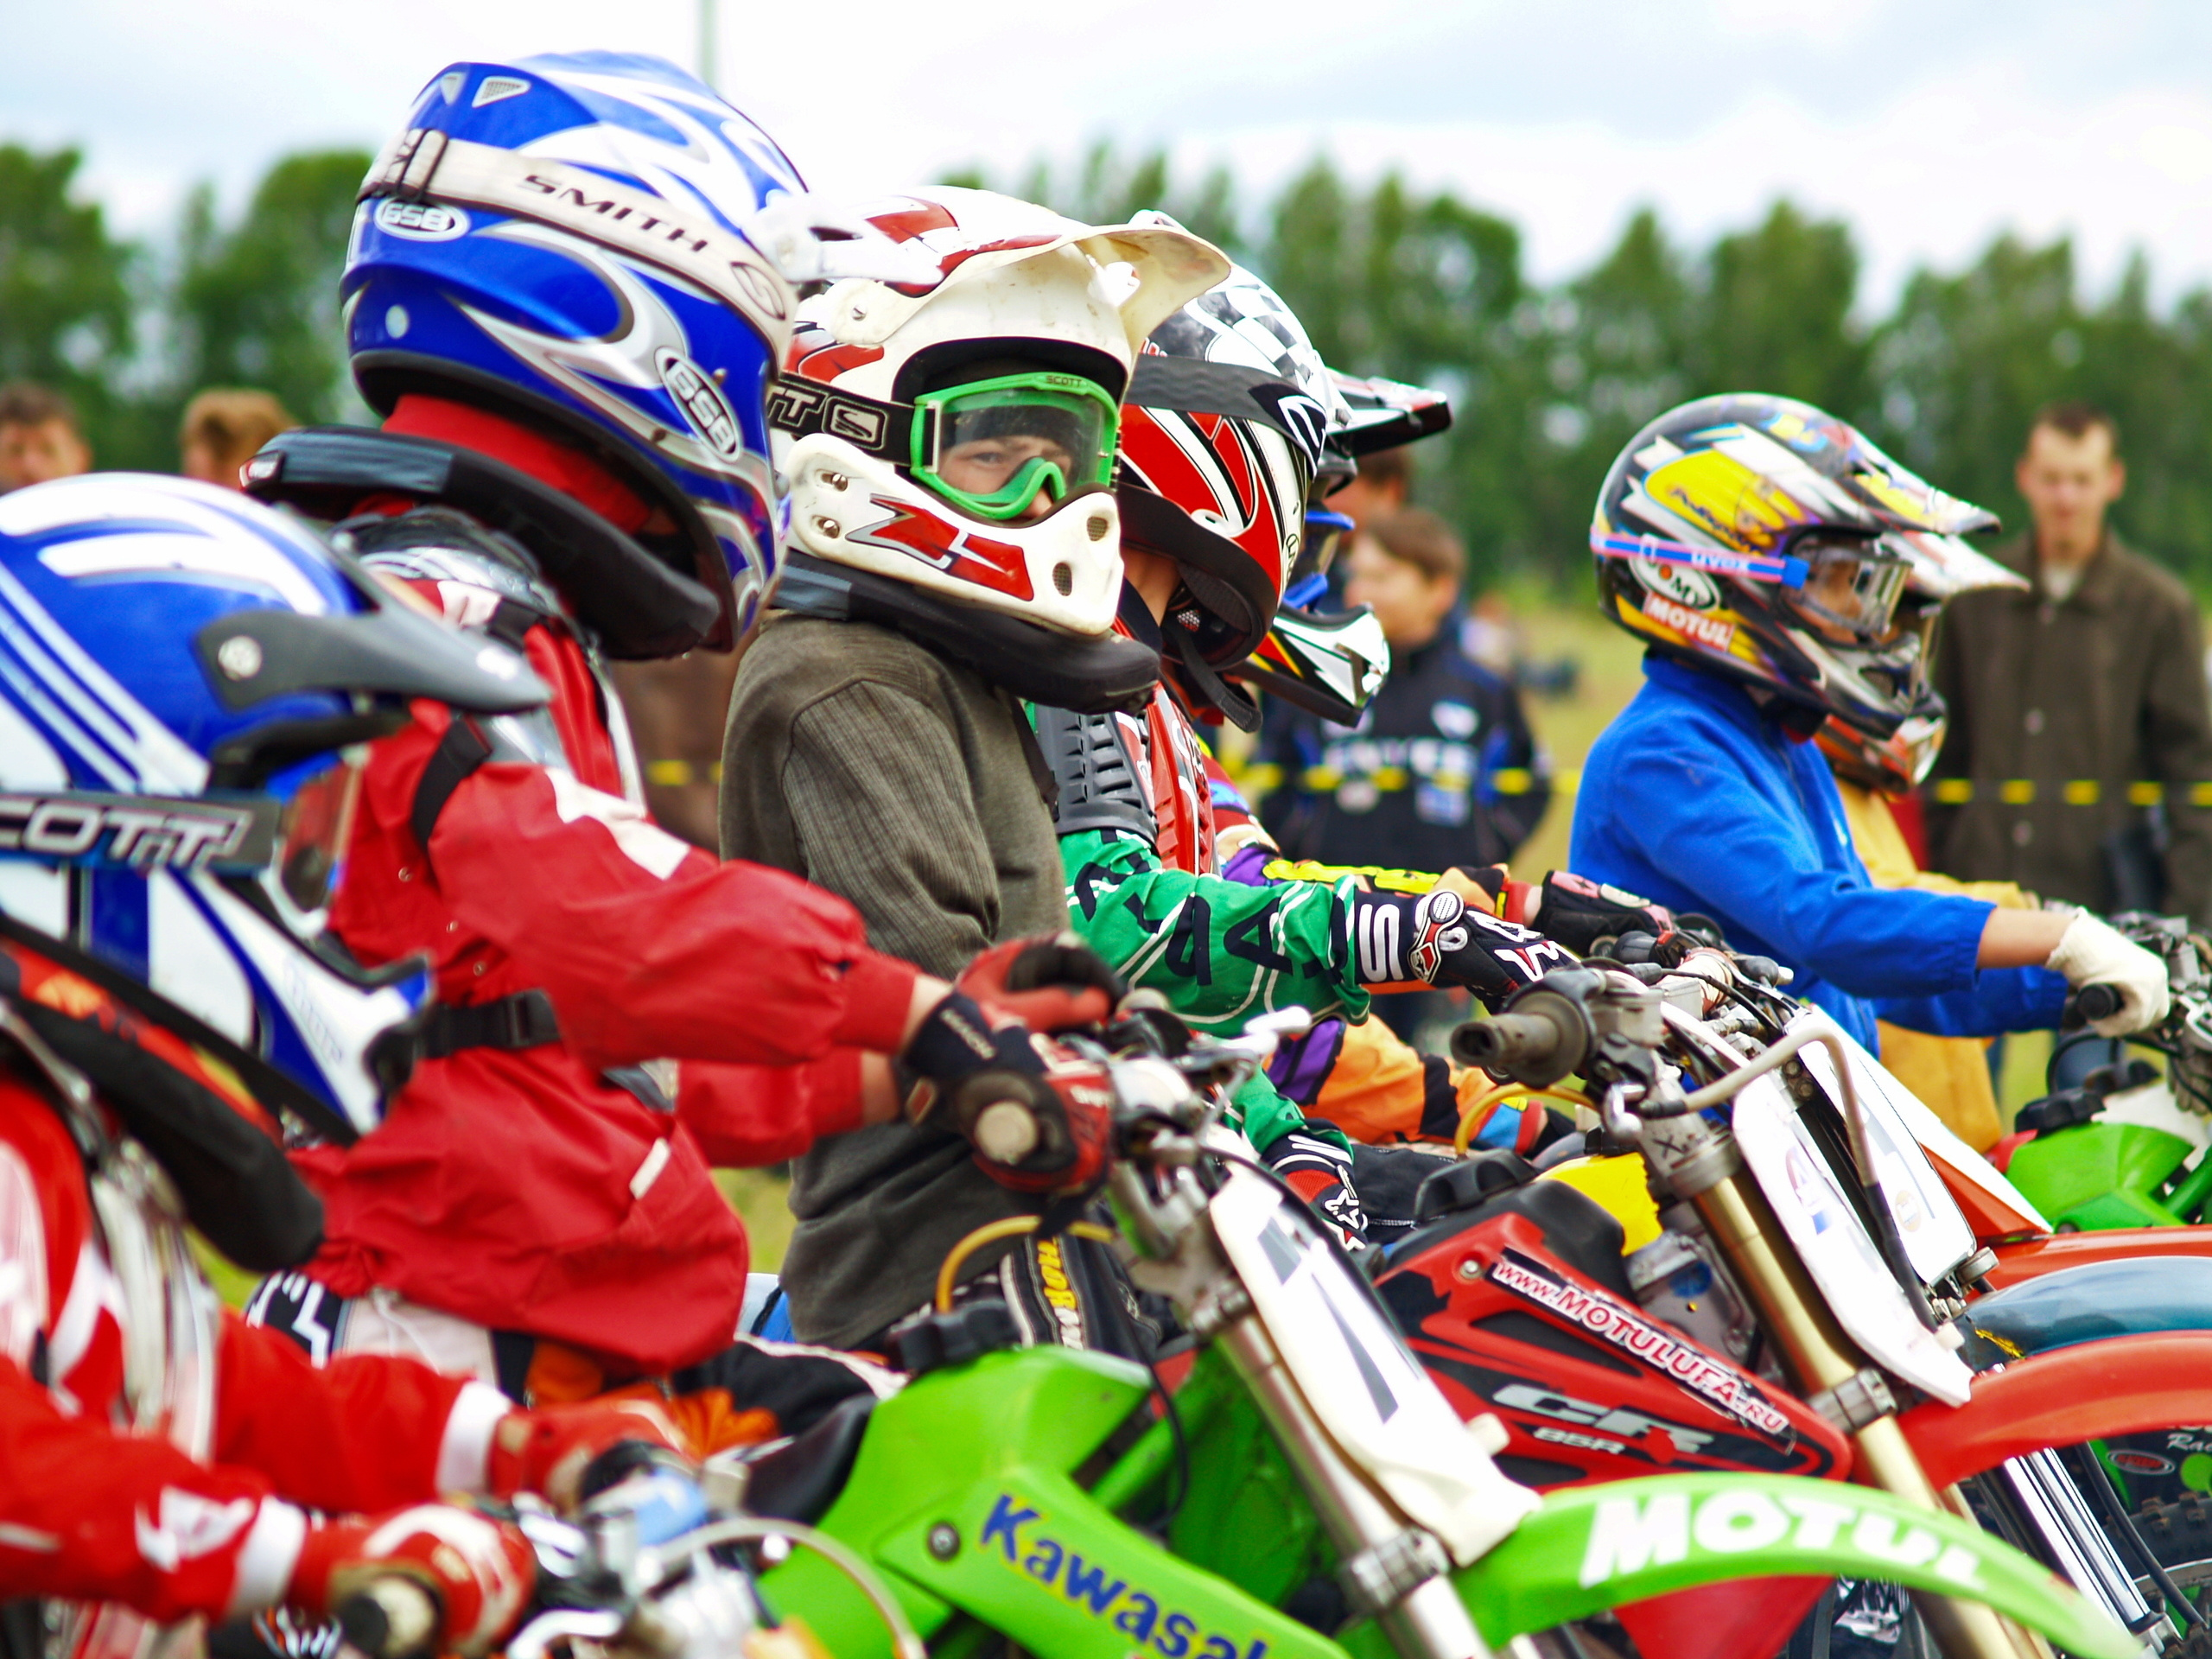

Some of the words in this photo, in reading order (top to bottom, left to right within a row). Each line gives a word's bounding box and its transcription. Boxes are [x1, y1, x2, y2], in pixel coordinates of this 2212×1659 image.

[522, 175, 709, 253] SMITH
[1046, 375, 1083, 388] SCOTT
[1691, 550, 1749, 575] uvex
[1647, 598, 1731, 648] MOTUL
[1579, 1491, 1985, 1589] MOTUL
